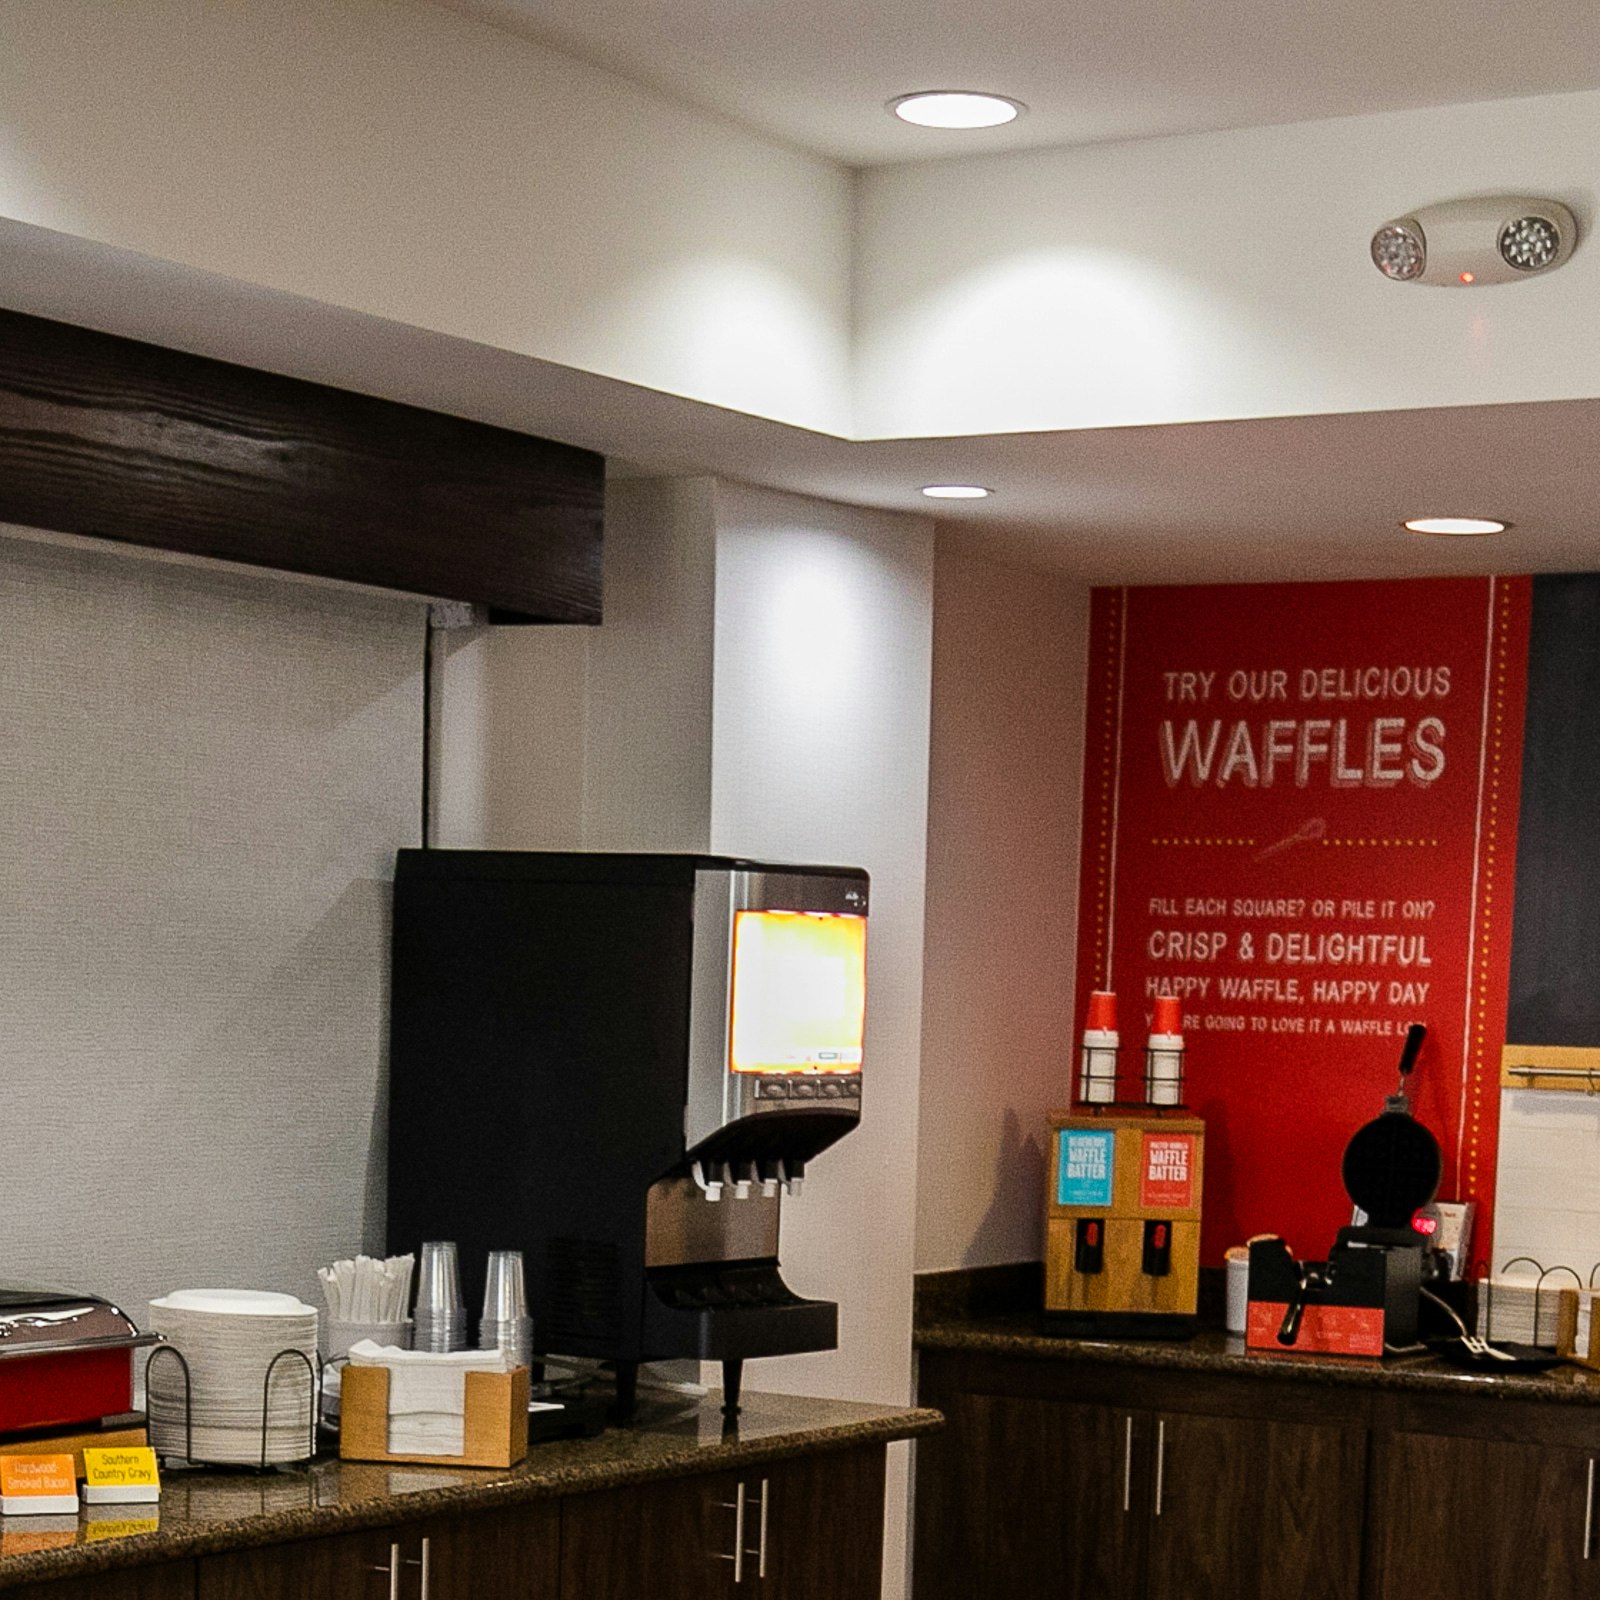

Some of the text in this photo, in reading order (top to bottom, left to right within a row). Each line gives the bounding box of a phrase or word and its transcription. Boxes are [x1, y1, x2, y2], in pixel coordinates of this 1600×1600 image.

[1163, 666, 1451, 700] TRY OUR DELICIOUS
[1159, 717, 1447, 787] WAFFLES
[1149, 898, 1435, 919] FILL EACH SQUARE? OR PILE IT ON?
[1149, 930, 1432, 966] CRISP & DELIGHTFUL
[1145, 976, 1211, 999] HAPPY
[1313, 980, 1380, 1003] HAPPY
[1388, 981, 1430, 1004] DAY
[1205, 1014, 1246, 1031] GOING
[1251, 1016, 1267, 1031] TO
[1272, 1016, 1305, 1033] LOVE
[1309, 1017, 1321, 1033] IT
[1326, 1018, 1336, 1034] A
[1342, 1019, 1392, 1035] WAFFLE
[1069, 1148, 1106, 1163] WAFFLE
[1150, 1150, 1188, 1165] WAFFLE
[1067, 1163, 1106, 1179] BATTER
[1148, 1166, 1187, 1182] BATTER
[102, 1454, 139, 1465] Southern
[93, 1467, 152, 1481] Country Gravy
[7, 1476, 70, 1489] Smoked Bacon
